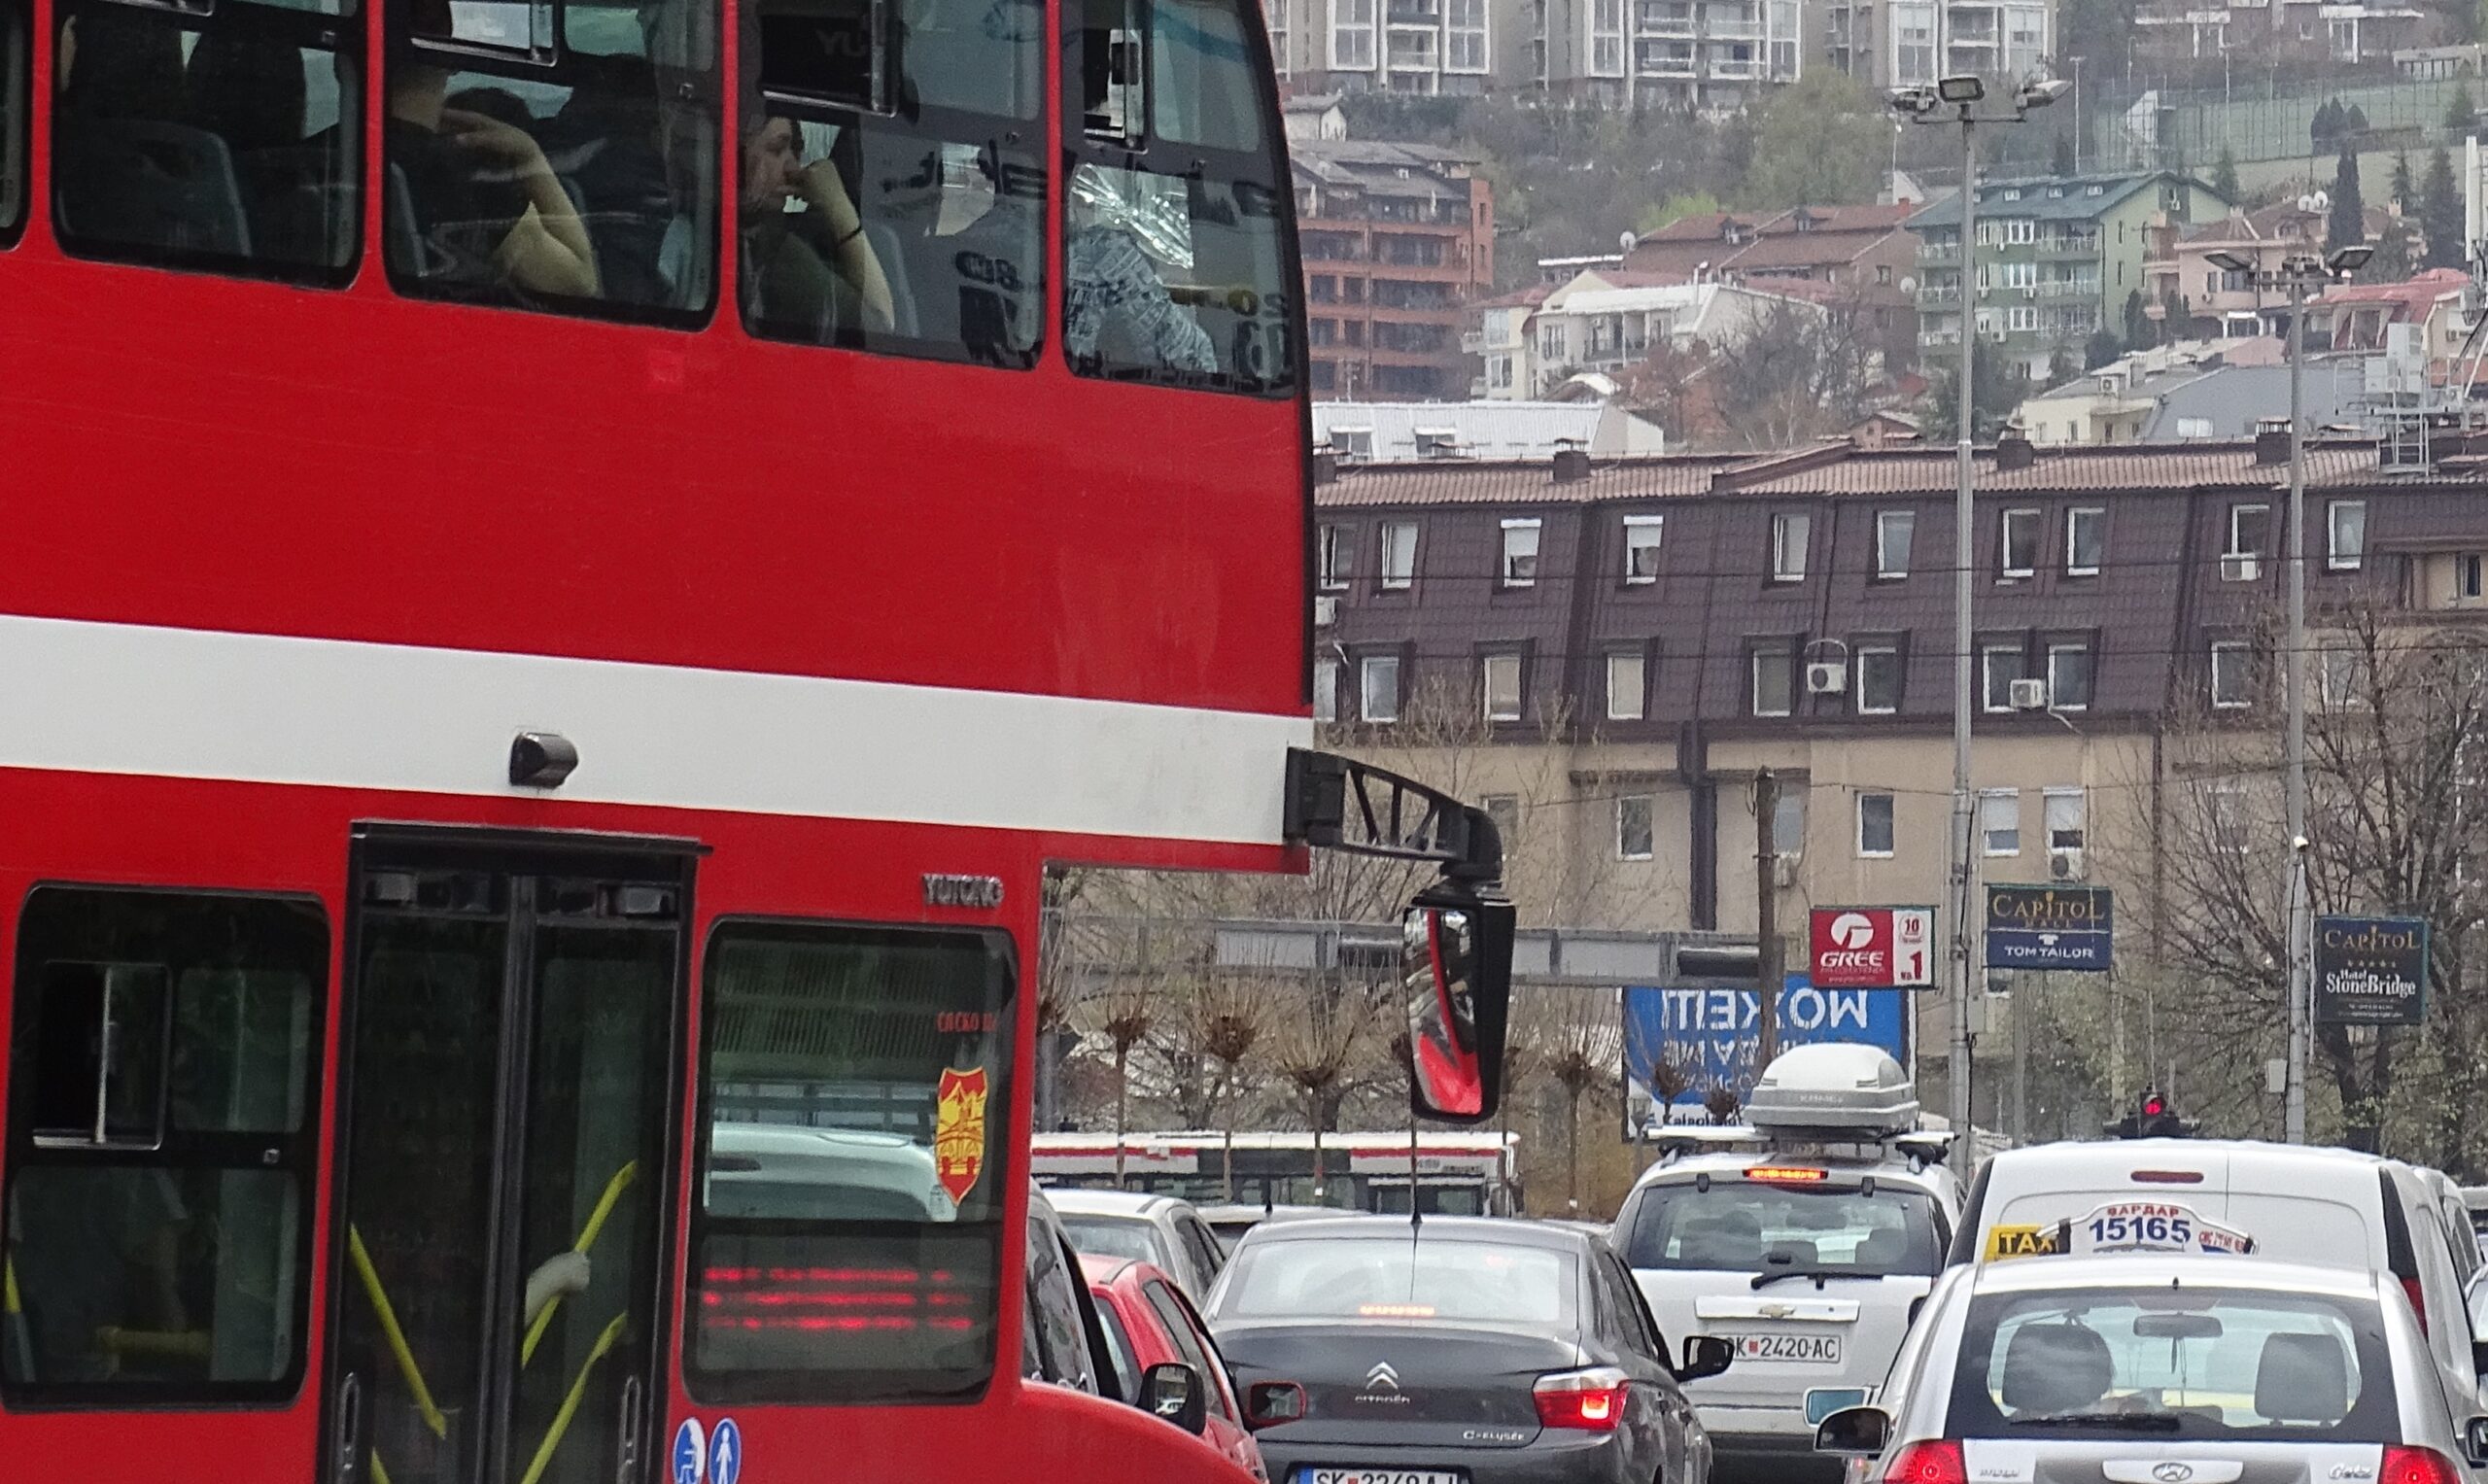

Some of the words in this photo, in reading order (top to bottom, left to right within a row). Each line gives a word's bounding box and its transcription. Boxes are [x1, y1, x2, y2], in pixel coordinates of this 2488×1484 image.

[1992, 891, 2105, 920] CAPITOL
[2324, 924, 2422, 951] CAPITOL
[1819, 950, 1884, 968] GREE
[2004, 946, 2037, 957] TOM
[2039, 948, 2094, 959] TAILOR
[2326, 972, 2416, 999] StoneBridge
[2339, 969, 2367, 980] Hotel
[2089, 1216, 2192, 1243] 15165
